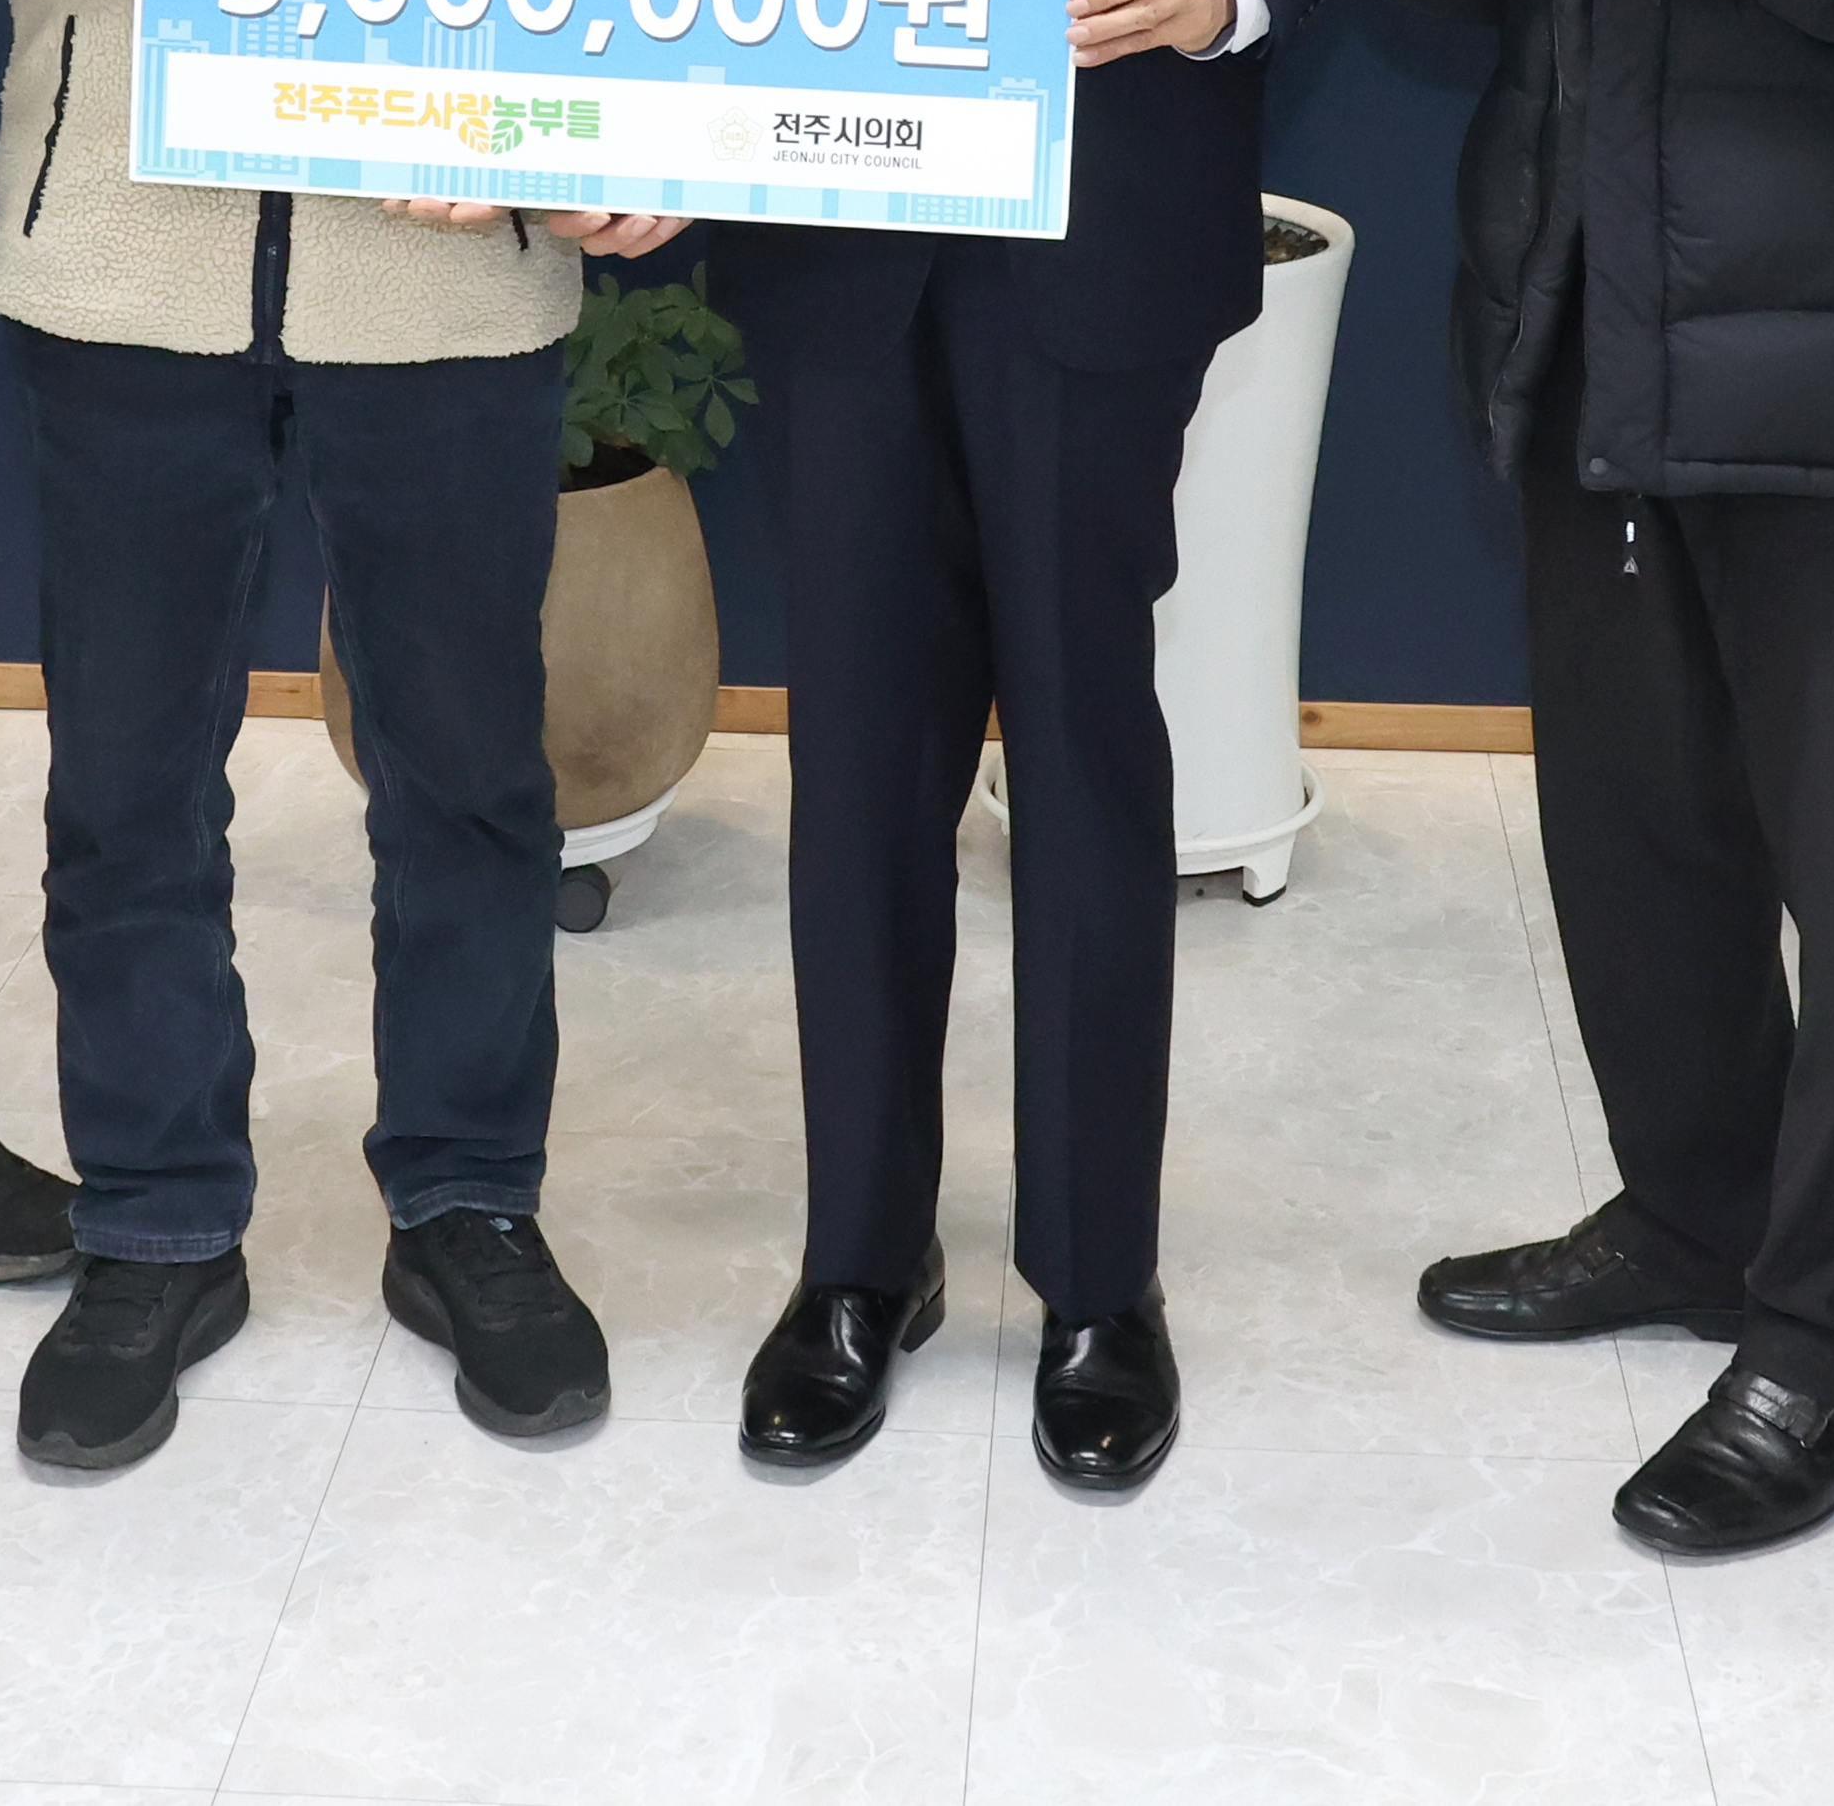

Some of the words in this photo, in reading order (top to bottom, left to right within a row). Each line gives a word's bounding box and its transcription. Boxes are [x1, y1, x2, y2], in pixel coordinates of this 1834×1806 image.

[273, 82, 602, 155] 전주푸드사랑농부들
[773, 112, 923, 151] 전주시의회
[773, 150, 826, 164] JEONJU
[830, 153, 859, 166] CITY
[864, 155, 922, 170] COUNCIL
